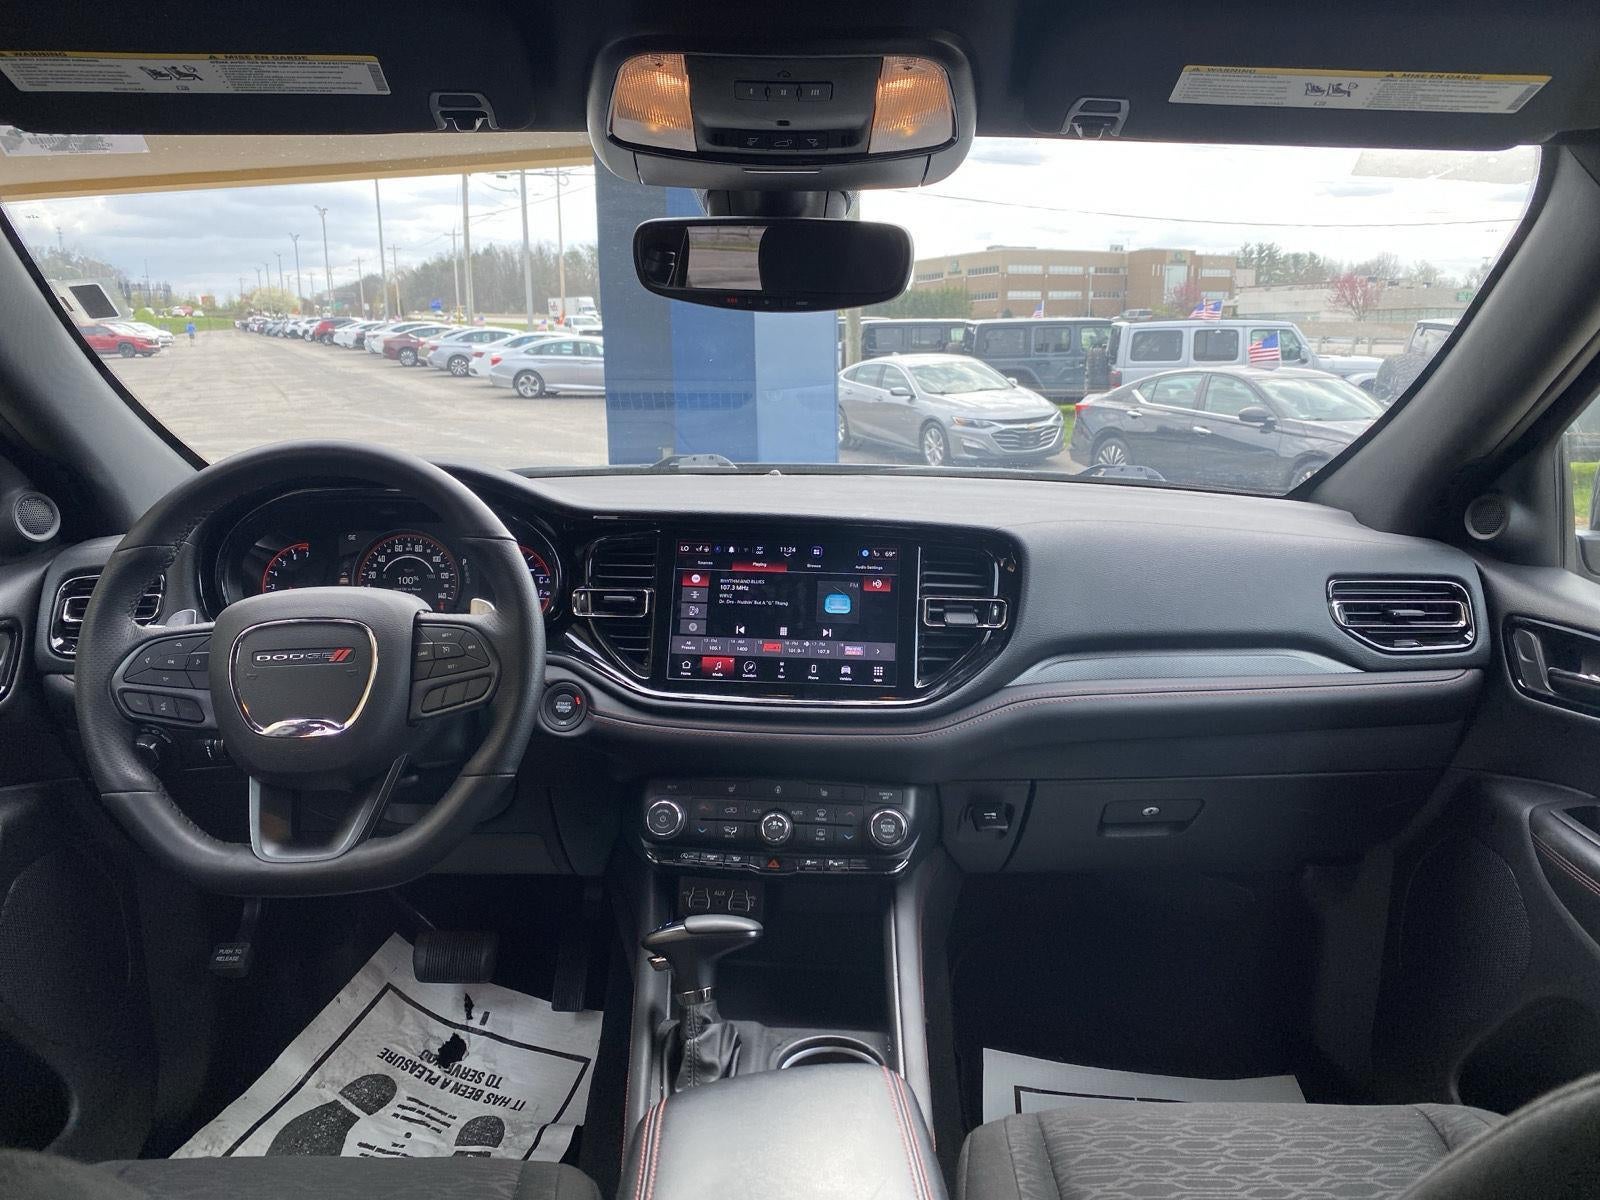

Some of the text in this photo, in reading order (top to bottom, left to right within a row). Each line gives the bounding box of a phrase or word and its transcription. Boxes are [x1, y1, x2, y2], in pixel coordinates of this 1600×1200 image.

[394, 544, 403, 552] 60
[368, 571, 377, 579] 20
[397, 575, 419, 585] 100%
[256, 652, 333, 661] DODGE
[376, 1047, 526, 1112] IT HAS BEEN A PLEASURE
[484, 1074, 504, 1089] TO
